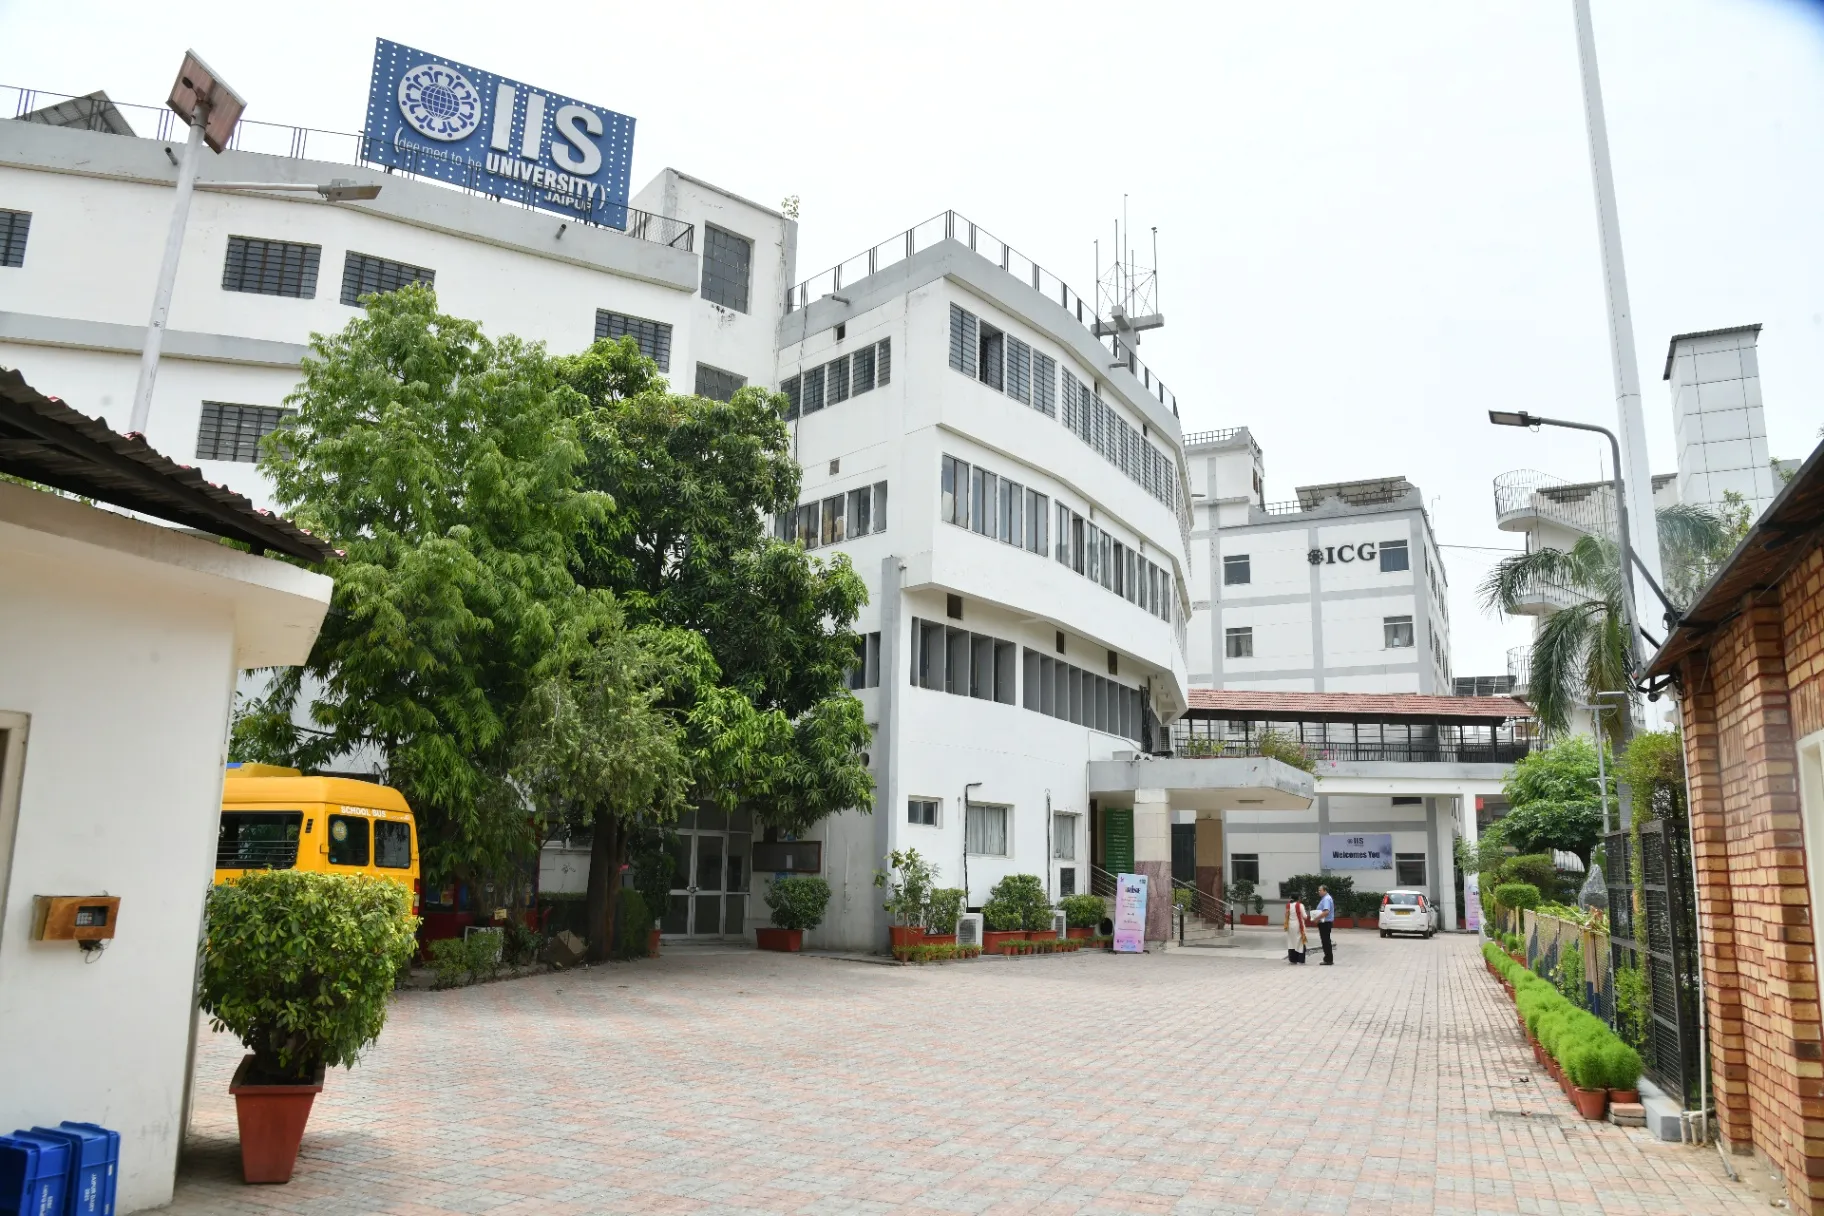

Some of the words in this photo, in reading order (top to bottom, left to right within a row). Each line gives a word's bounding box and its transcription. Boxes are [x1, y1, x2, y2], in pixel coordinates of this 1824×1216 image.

[490, 83, 603, 176] IIS
[451, 151, 462, 166] to
[1325, 542, 1377, 564] ICG
[341, 806, 371, 816] SCHOOL
[372, 809, 386, 817] BUS
